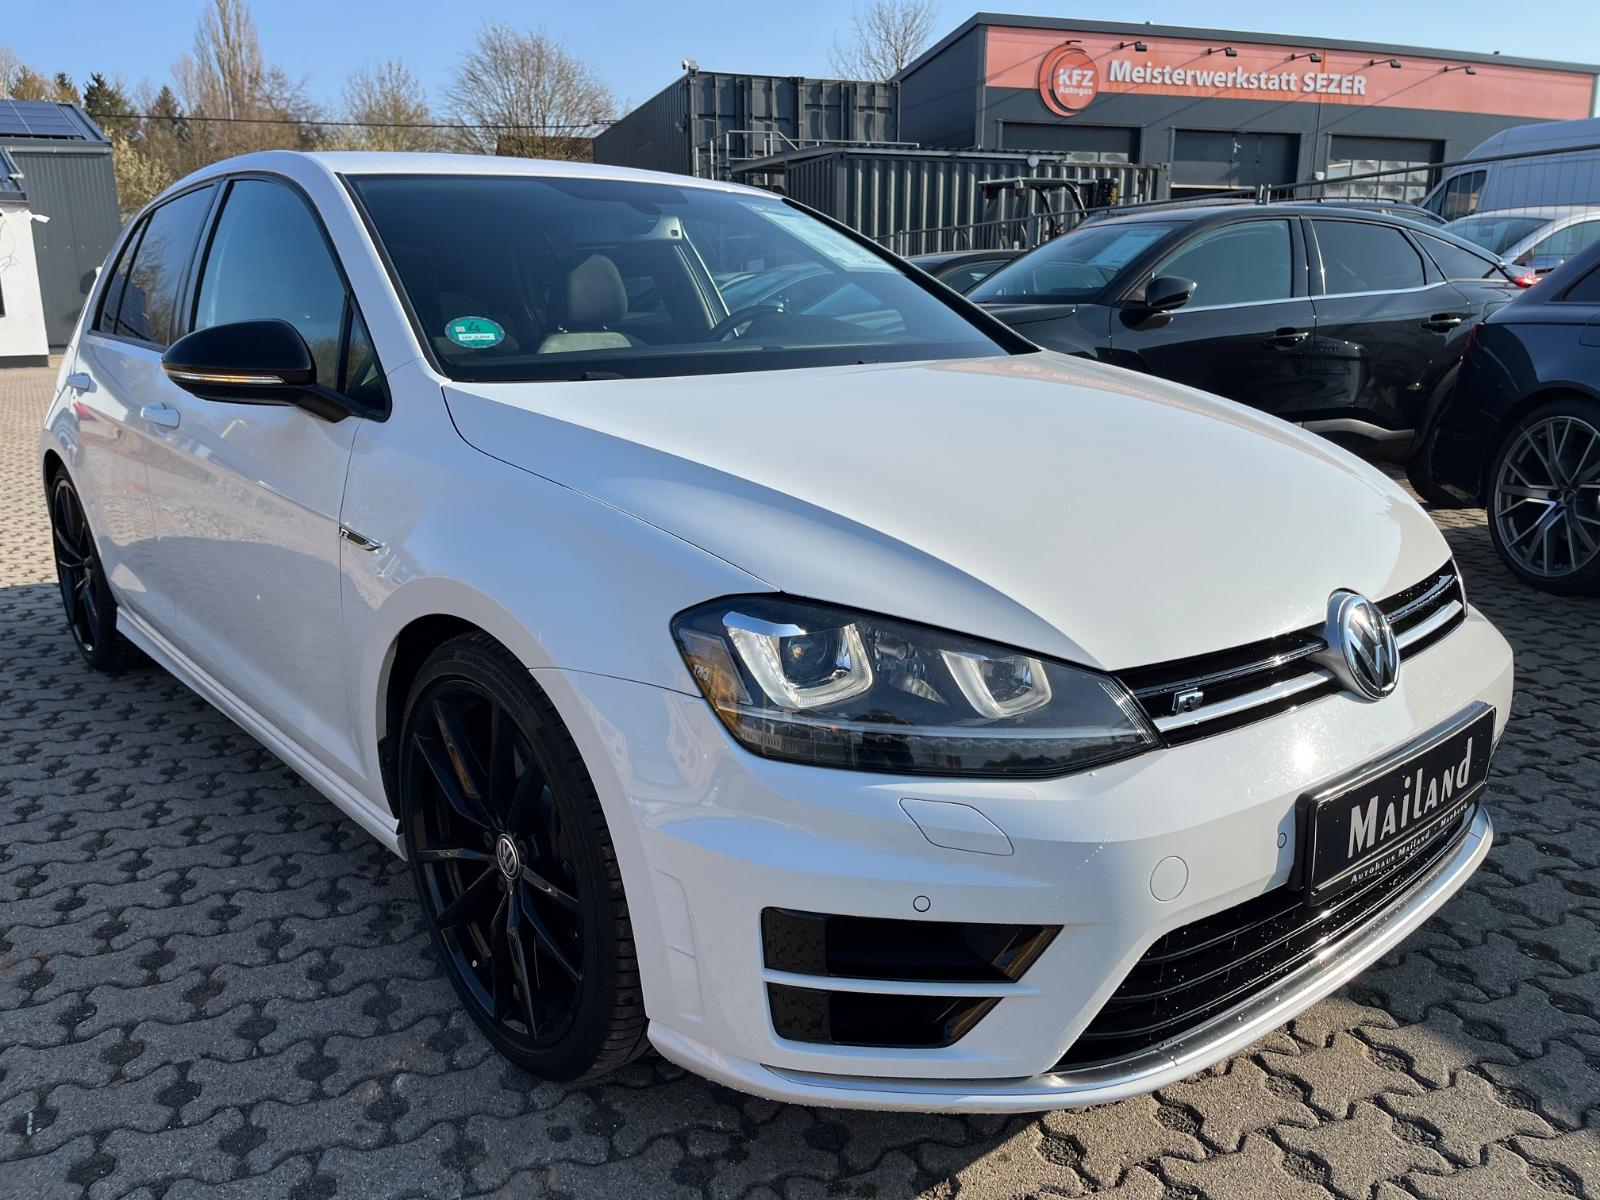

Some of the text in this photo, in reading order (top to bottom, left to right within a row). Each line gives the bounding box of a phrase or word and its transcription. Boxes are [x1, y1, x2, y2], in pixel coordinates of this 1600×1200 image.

[1059, 68, 1094, 87] KFZ
[1109, 60, 1367, 96] Meisterwerkstatt SEZER
[1058, 86, 1093, 97] Autogas
[467, 320, 481, 332] 4
